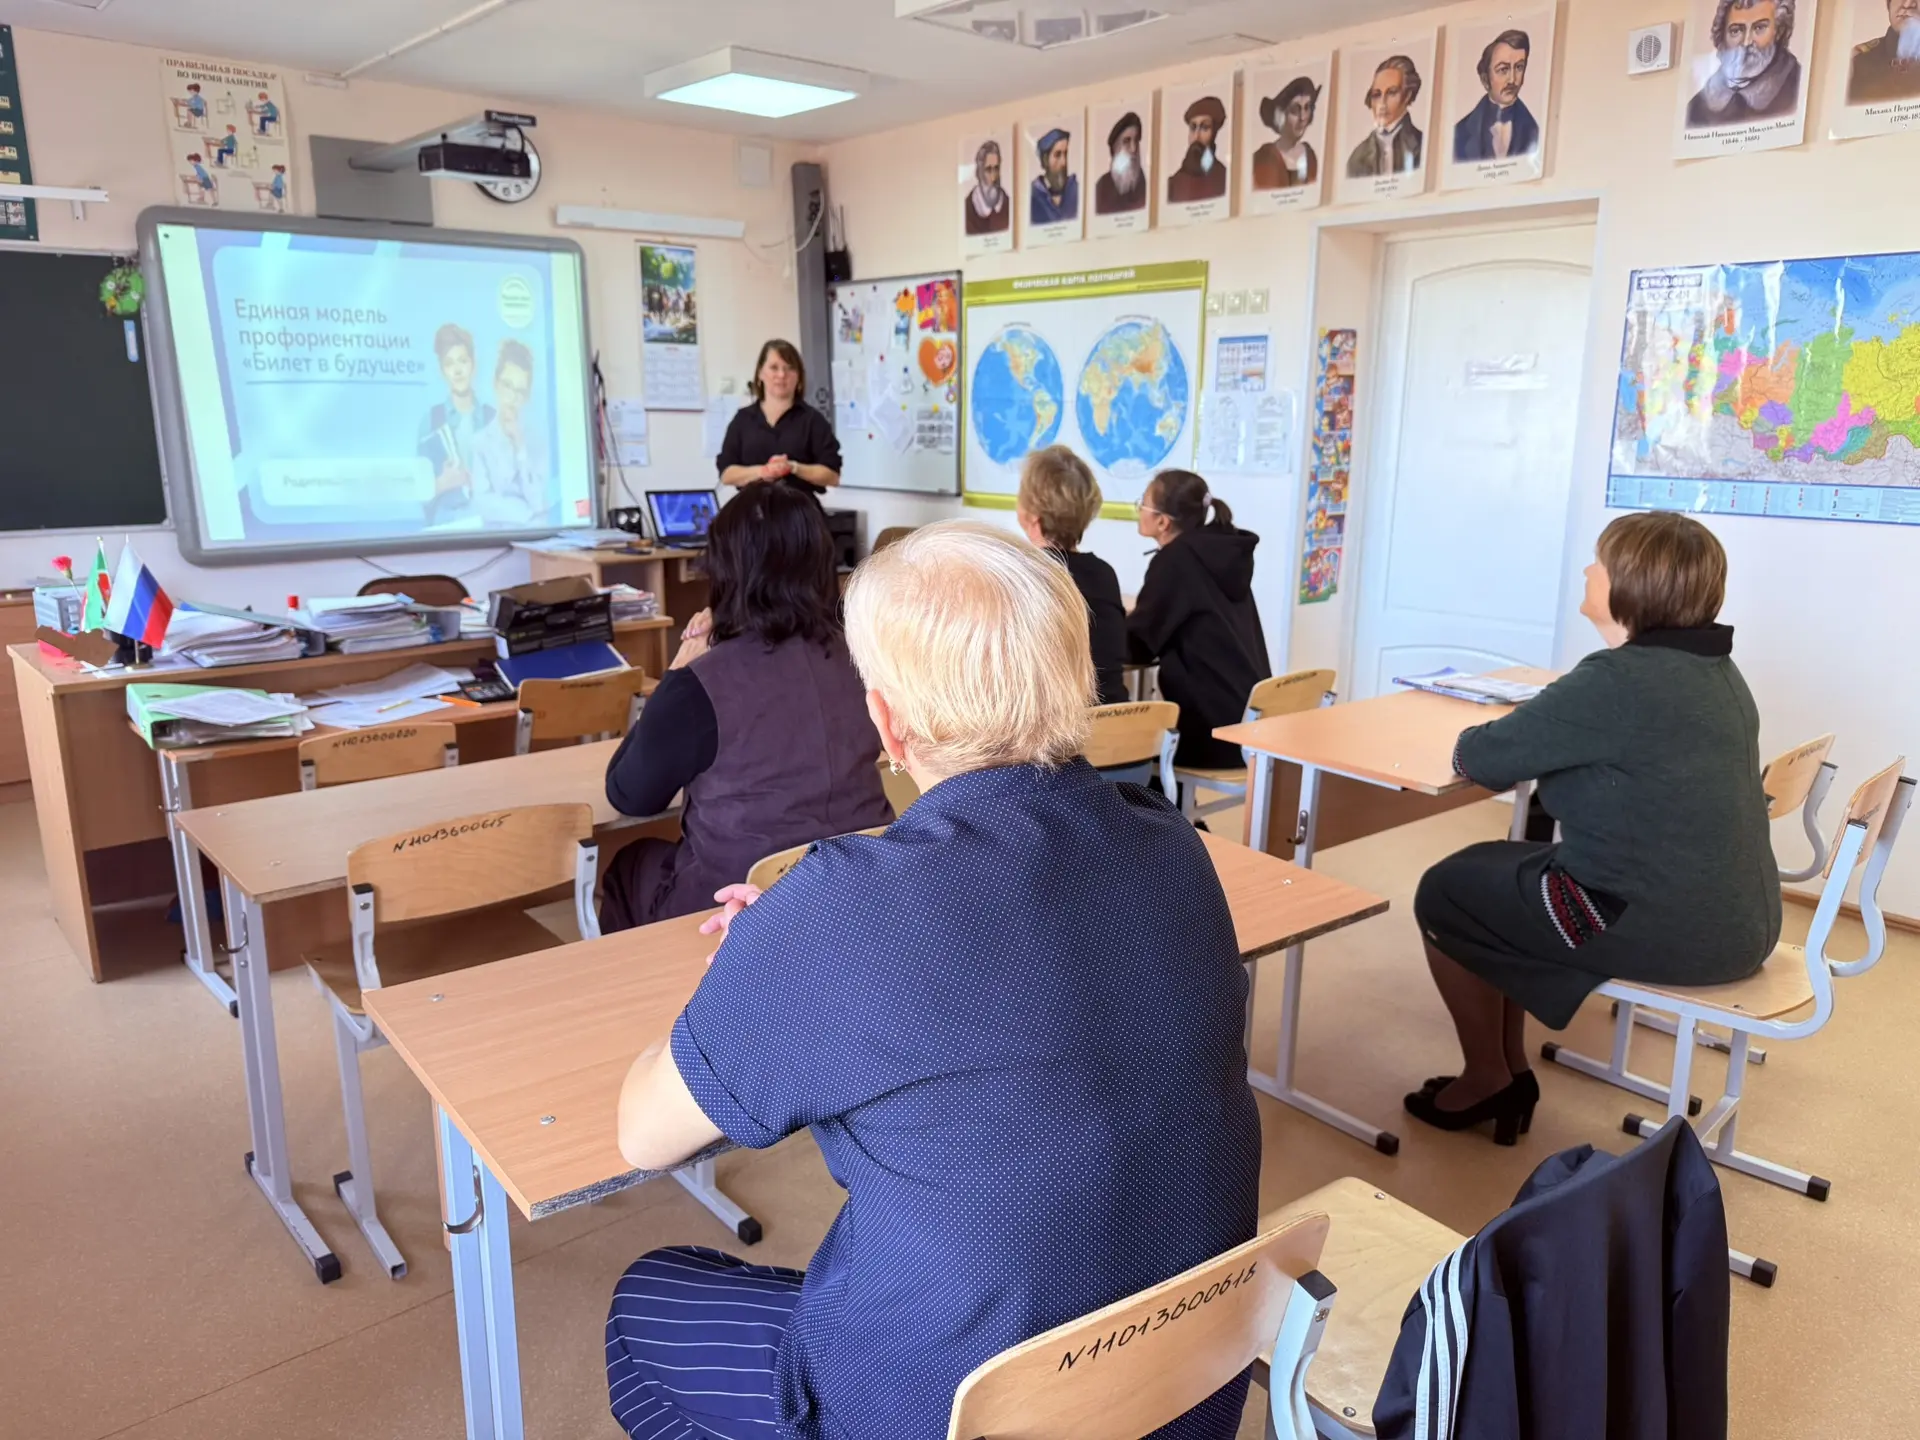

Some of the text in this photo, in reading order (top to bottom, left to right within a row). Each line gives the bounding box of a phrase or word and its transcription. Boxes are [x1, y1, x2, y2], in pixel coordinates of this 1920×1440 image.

[165, 59, 231, 75] ПРАВИЛЬНАЯ
[176, 70, 189, 79] ВО
[191, 72, 223, 84] ВРЕМЯ
[1865, 107, 1892, 116] Михаил
[234, 298, 388, 325] Единая модель
[239, 326, 411, 352] профориентации
[243, 352, 425, 379] «Билет в будущее»
